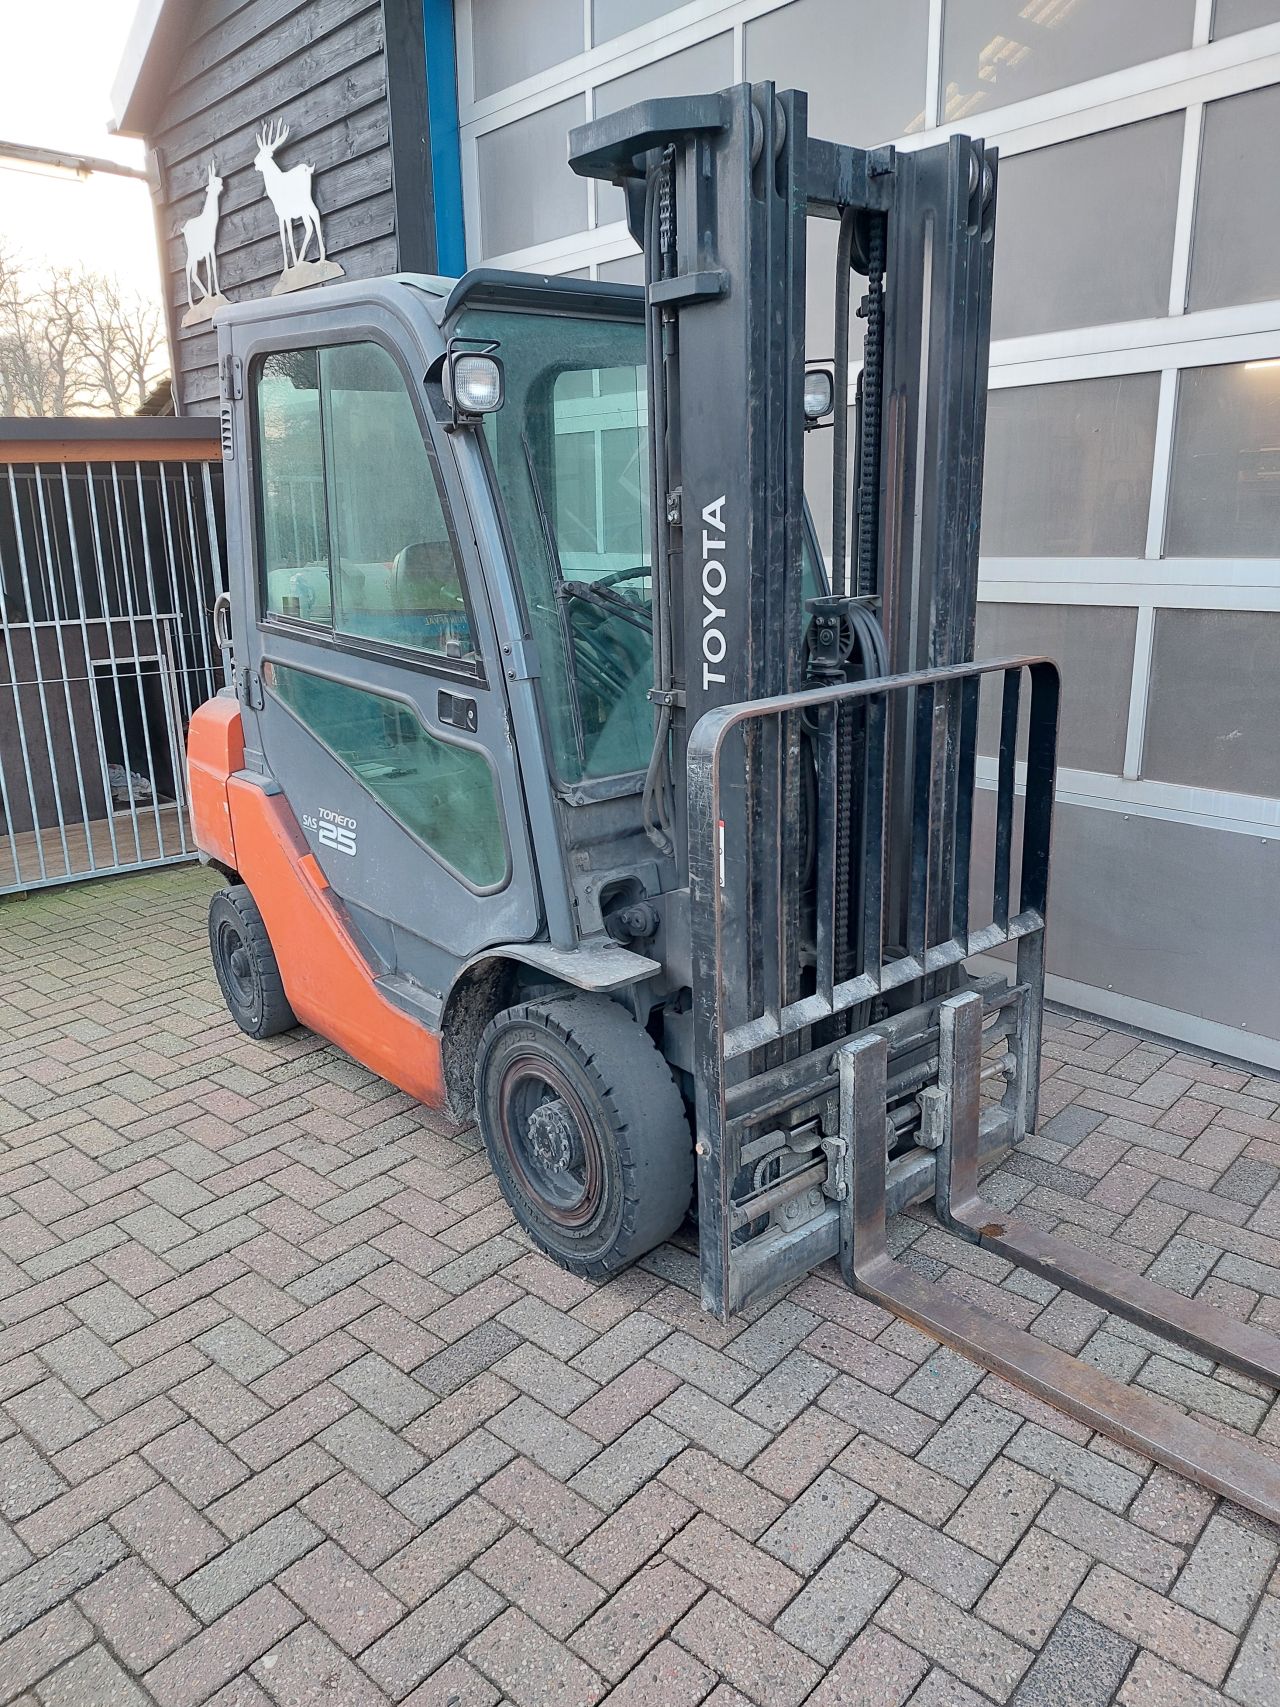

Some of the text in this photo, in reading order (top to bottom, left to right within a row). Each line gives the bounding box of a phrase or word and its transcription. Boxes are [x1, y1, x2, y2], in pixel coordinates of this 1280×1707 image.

[701, 494, 727, 691] TOYOTA
[302, 814, 318, 830] SAS
[318, 807, 357, 830] TONERO
[318, 820, 357, 857] 25
